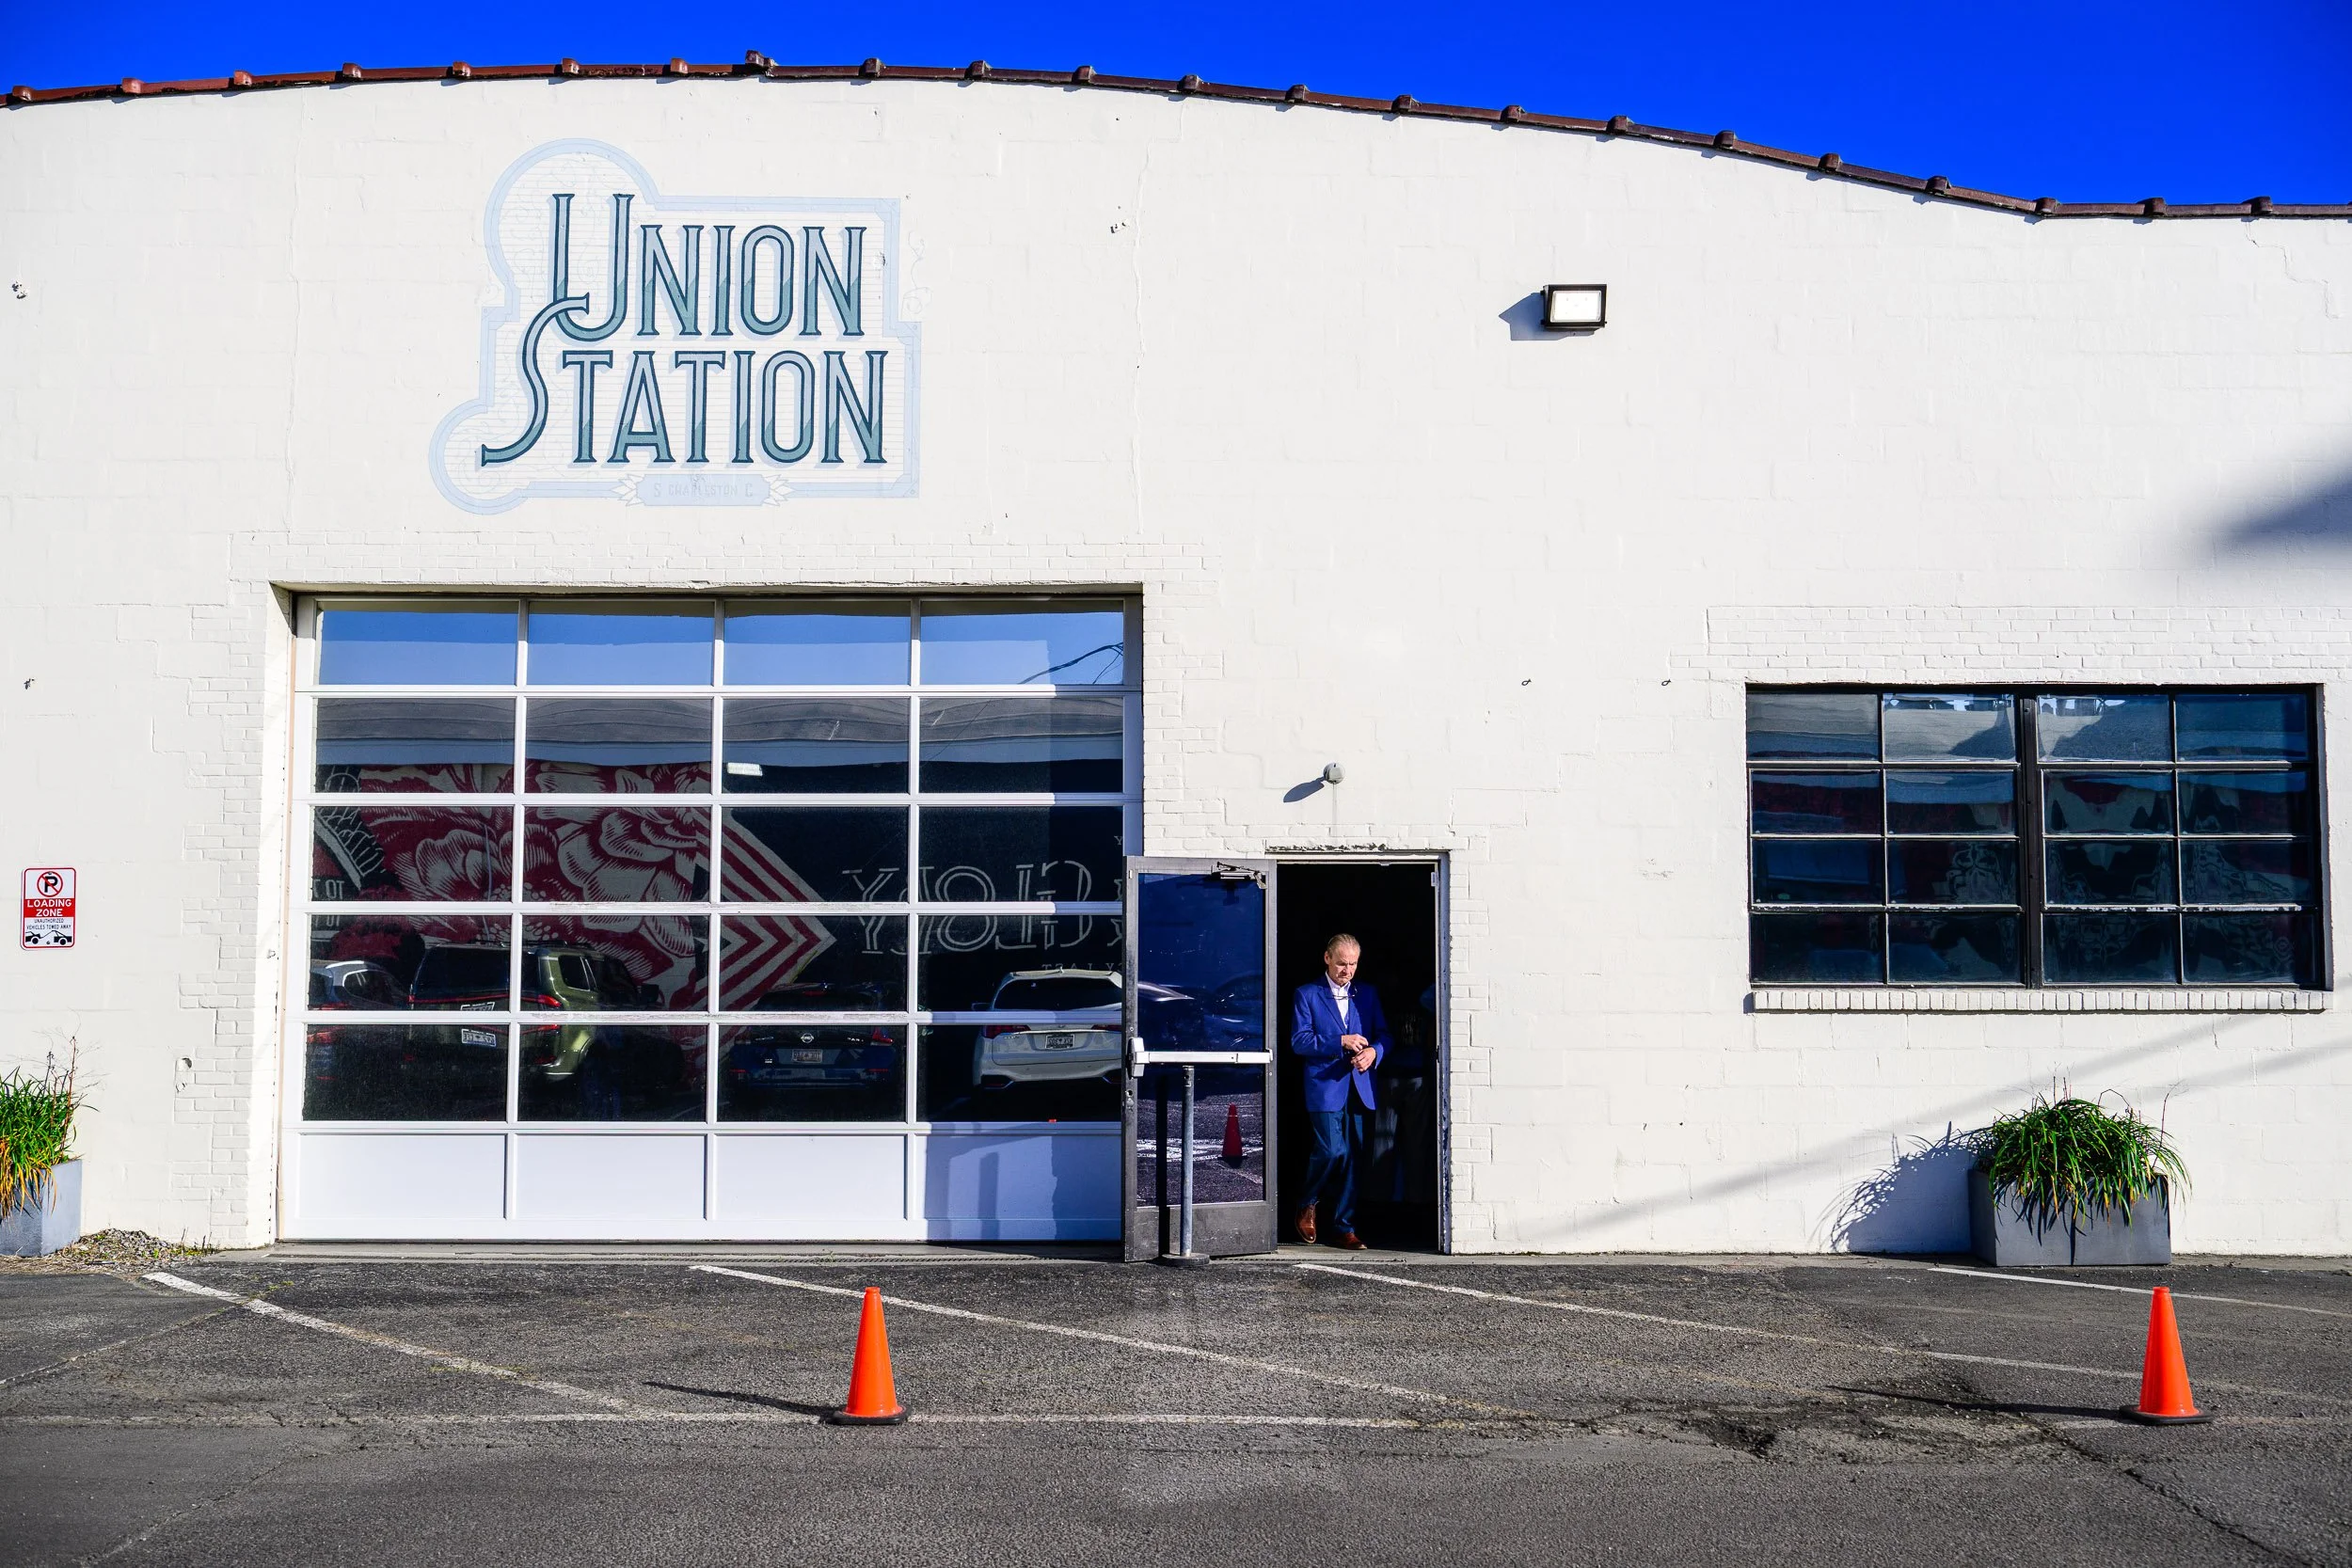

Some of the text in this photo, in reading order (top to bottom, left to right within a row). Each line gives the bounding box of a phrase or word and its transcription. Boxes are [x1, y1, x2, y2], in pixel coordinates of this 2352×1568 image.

[551, 193, 866, 341] UNION
[481, 292, 889, 467] STATION
[26, 899, 72, 908] LOADING
[36, 909, 63, 917] ZONE
